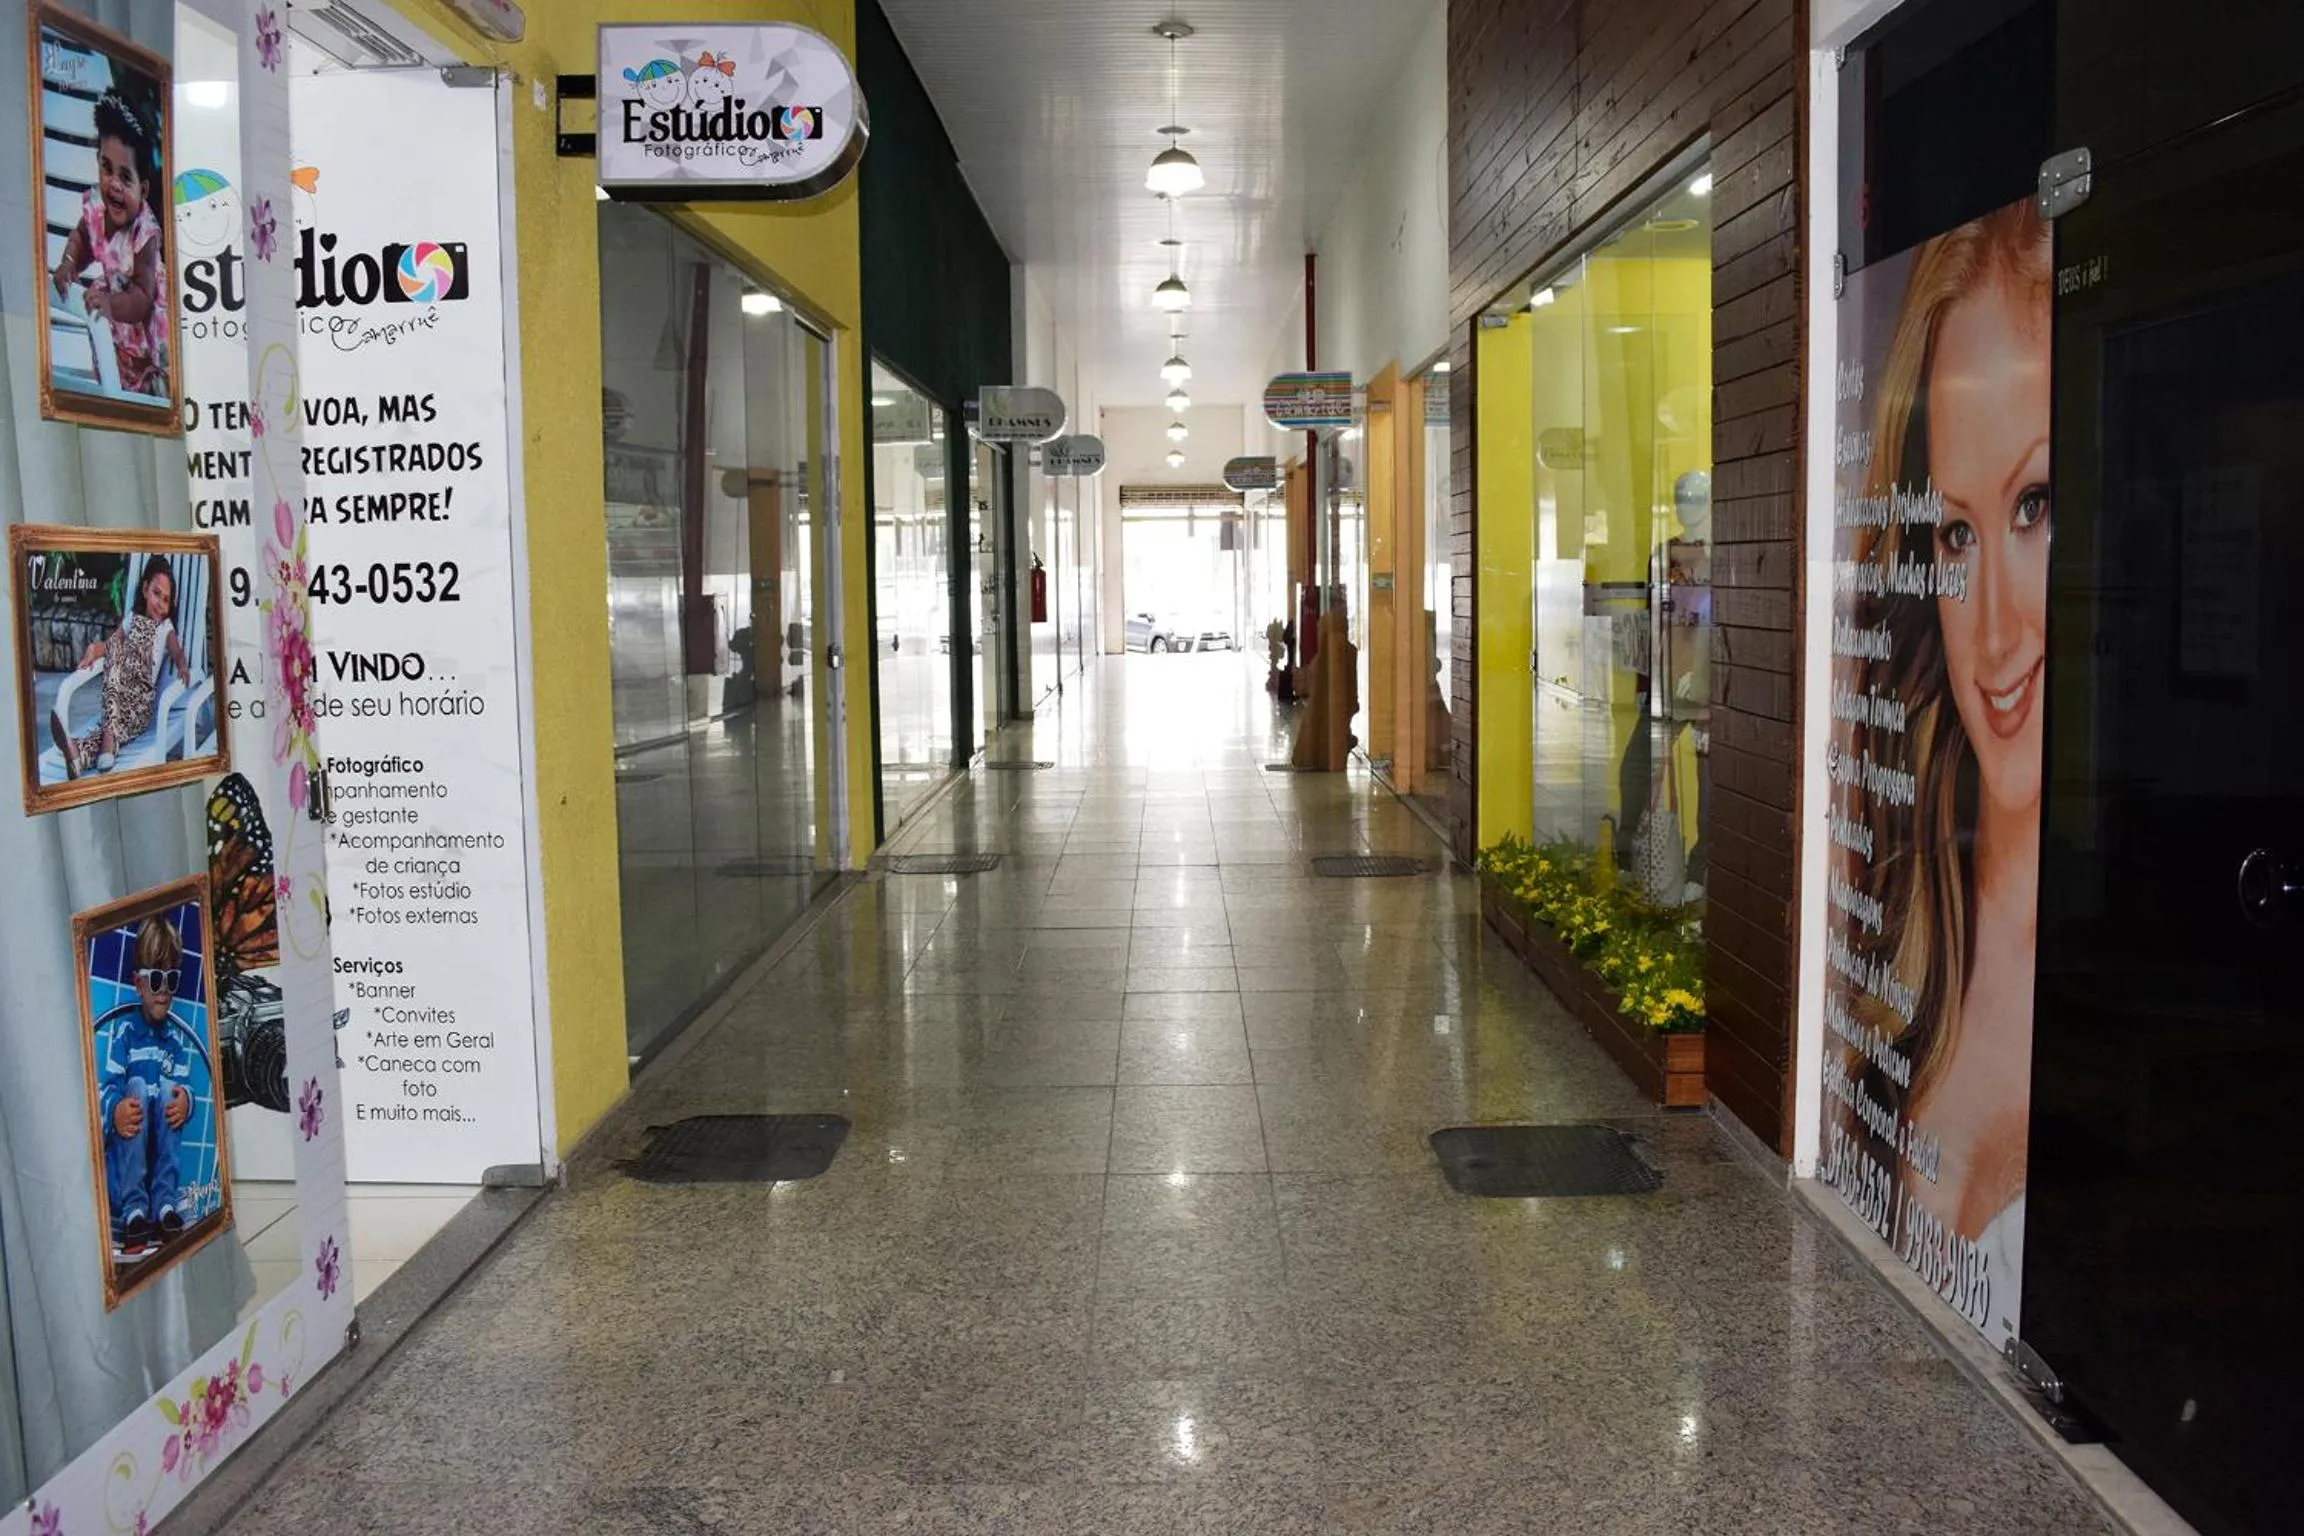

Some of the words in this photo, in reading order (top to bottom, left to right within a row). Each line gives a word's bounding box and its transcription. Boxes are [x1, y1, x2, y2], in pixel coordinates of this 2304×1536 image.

[621, 95, 771, 144] Estúdio
[645, 142, 747, 160] Fotográfico
[303, 396, 369, 427] VOA,
[378, 392, 437, 424] MAS
[335, 486, 454, 525] SEMPRE!
[350, 697, 392, 717] seu
[399, 689, 486, 717] horário
[327, 755, 424, 777] Fotográfico
[342, 807, 419, 828] gestante
[365, 858, 388, 874] de
[394, 857, 461, 876] criança
[409, 881, 472, 899] estúdio
[405, 909, 479, 924] externas
[333, 957, 404, 977] Serviços
[414, 1035, 442, 1049] em
[446, 1031, 495, 1049] Geral
[441, 1058, 481, 1073] com
[402, 1079, 438, 1098] foto
[356, 1104, 367, 1120] E
[370, 1104, 419, 1122] muito
[423, 1105, 476, 1122] mais...
